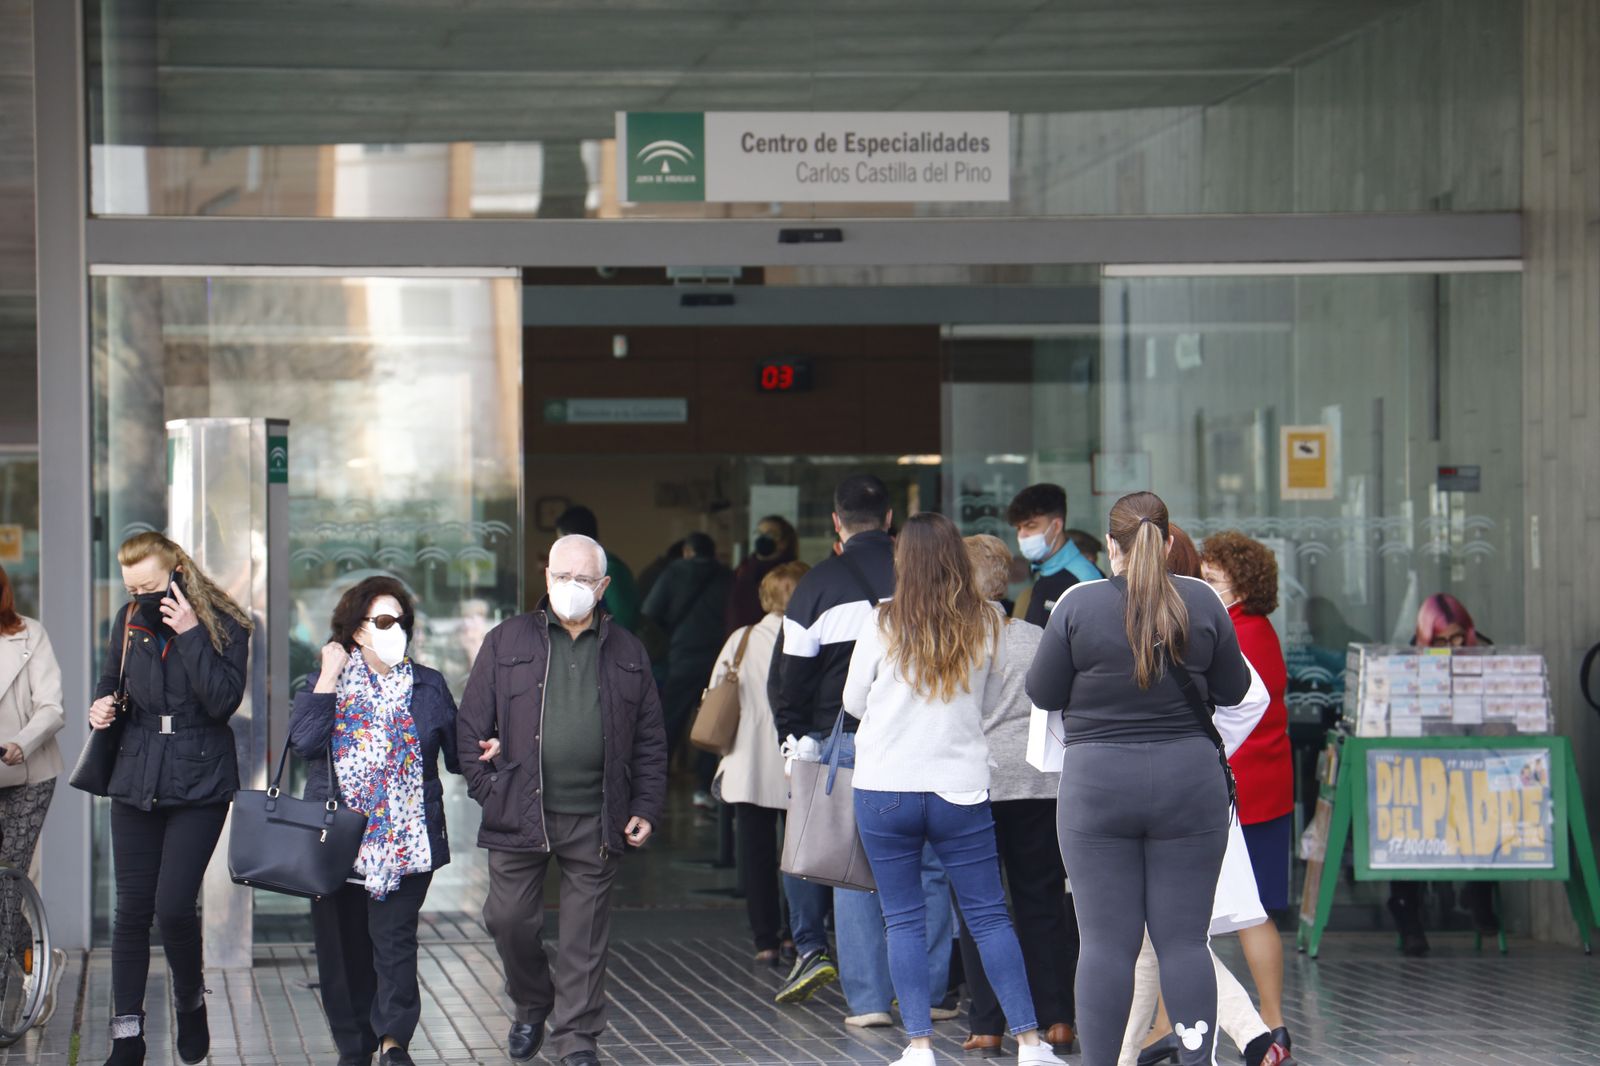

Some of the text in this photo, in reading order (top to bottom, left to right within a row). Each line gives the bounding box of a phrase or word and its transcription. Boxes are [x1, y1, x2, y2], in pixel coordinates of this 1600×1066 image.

[741, 131, 991, 157] Centro de Especialidades
[796, 161, 993, 183] Carlos Castilla del Pino
[761, 365, 794, 389] 03
[1376, 756, 1419, 805] DÍA
[1421, 757, 1546, 856] PADRE
[1377, 807, 1421, 841] DEL
